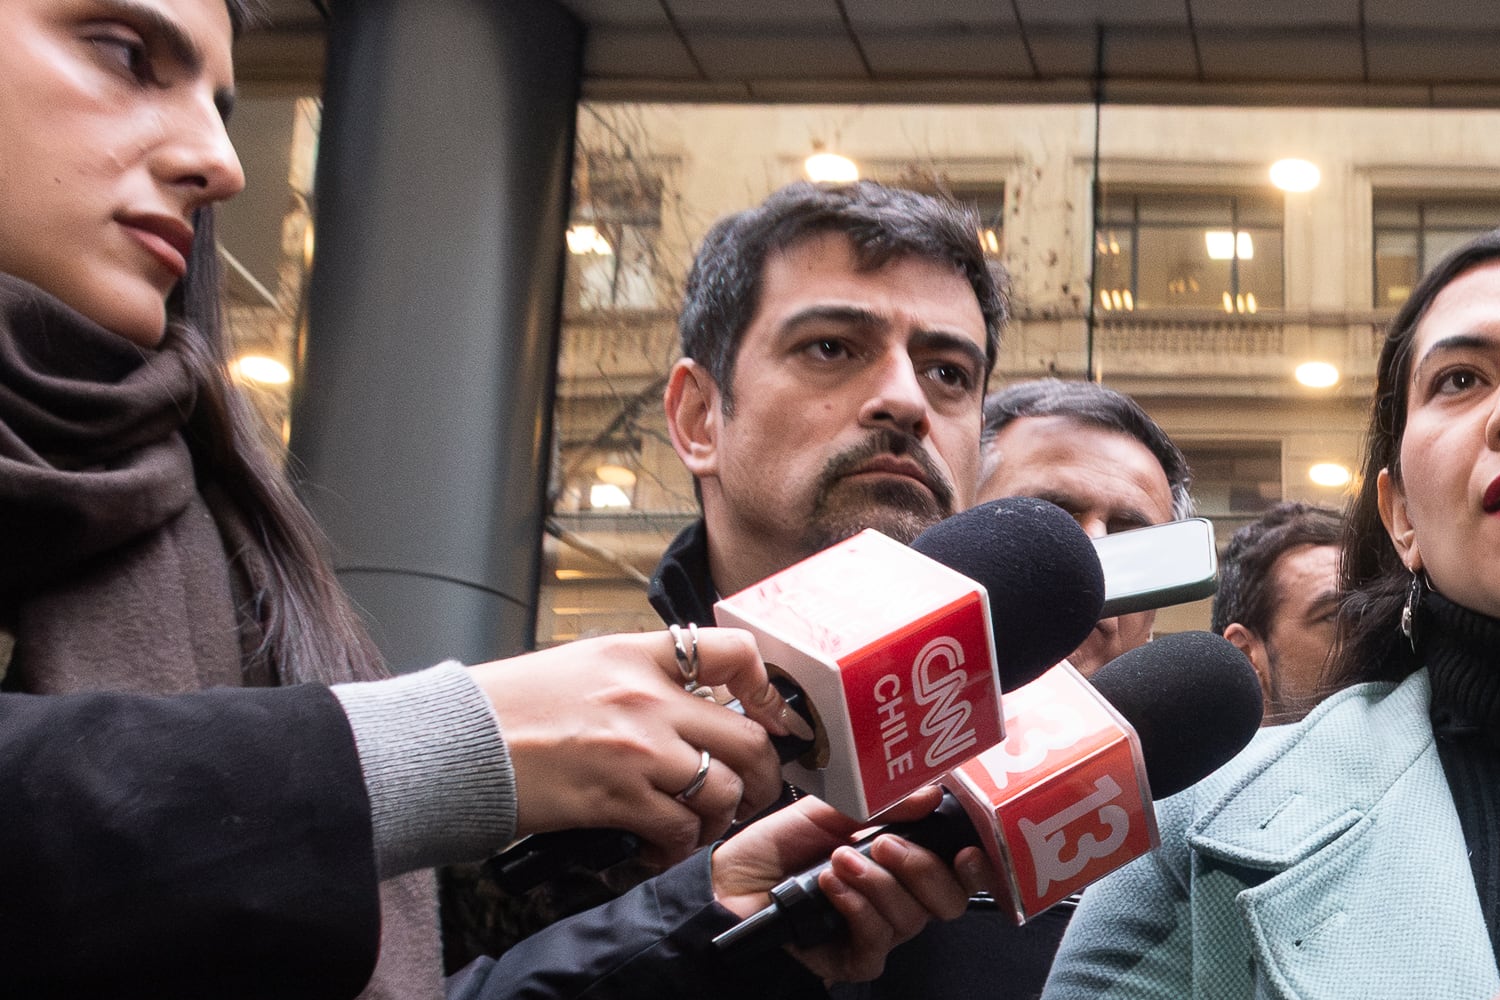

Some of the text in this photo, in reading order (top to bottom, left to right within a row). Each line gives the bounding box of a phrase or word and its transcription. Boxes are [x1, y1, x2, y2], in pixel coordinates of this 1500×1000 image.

[873, 673, 913, 781] CHILE
[911, 635, 977, 769] CNN
[1017, 774, 1130, 899] 13
